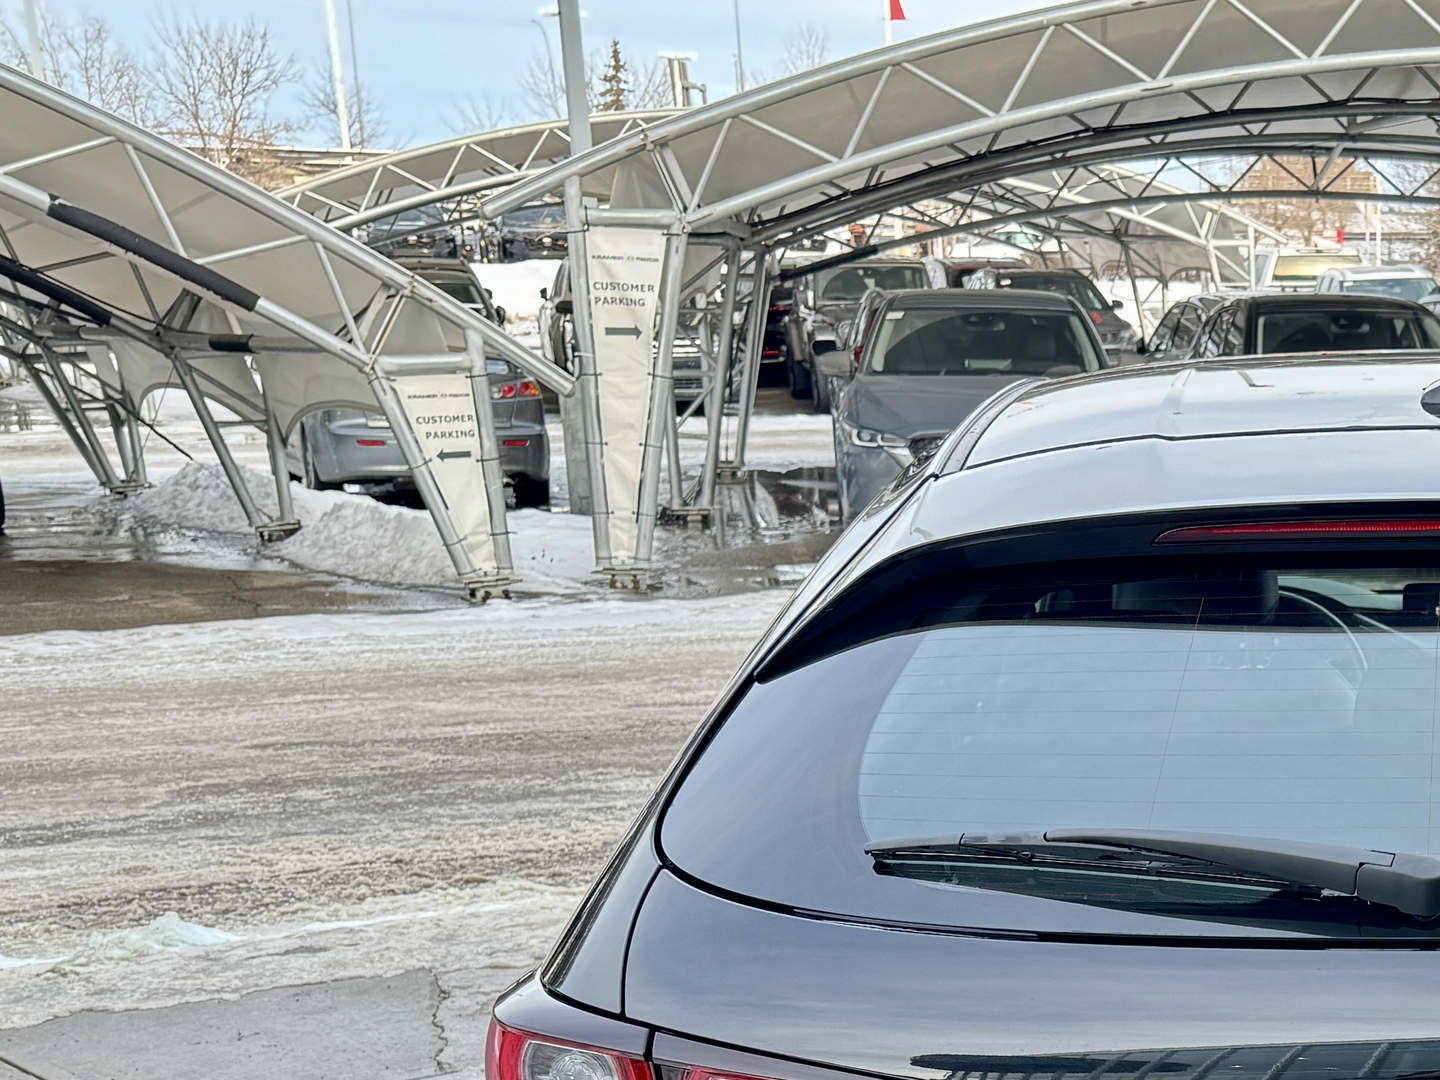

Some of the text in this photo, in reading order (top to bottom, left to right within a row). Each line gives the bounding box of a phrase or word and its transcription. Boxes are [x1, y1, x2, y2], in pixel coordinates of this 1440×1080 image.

[593, 281, 655, 293] CUSTOMER
[594, 296, 646, 307] PARKING
[416, 414, 474, 425] CUSTOMER
[425, 429, 475, 440] PARKING
